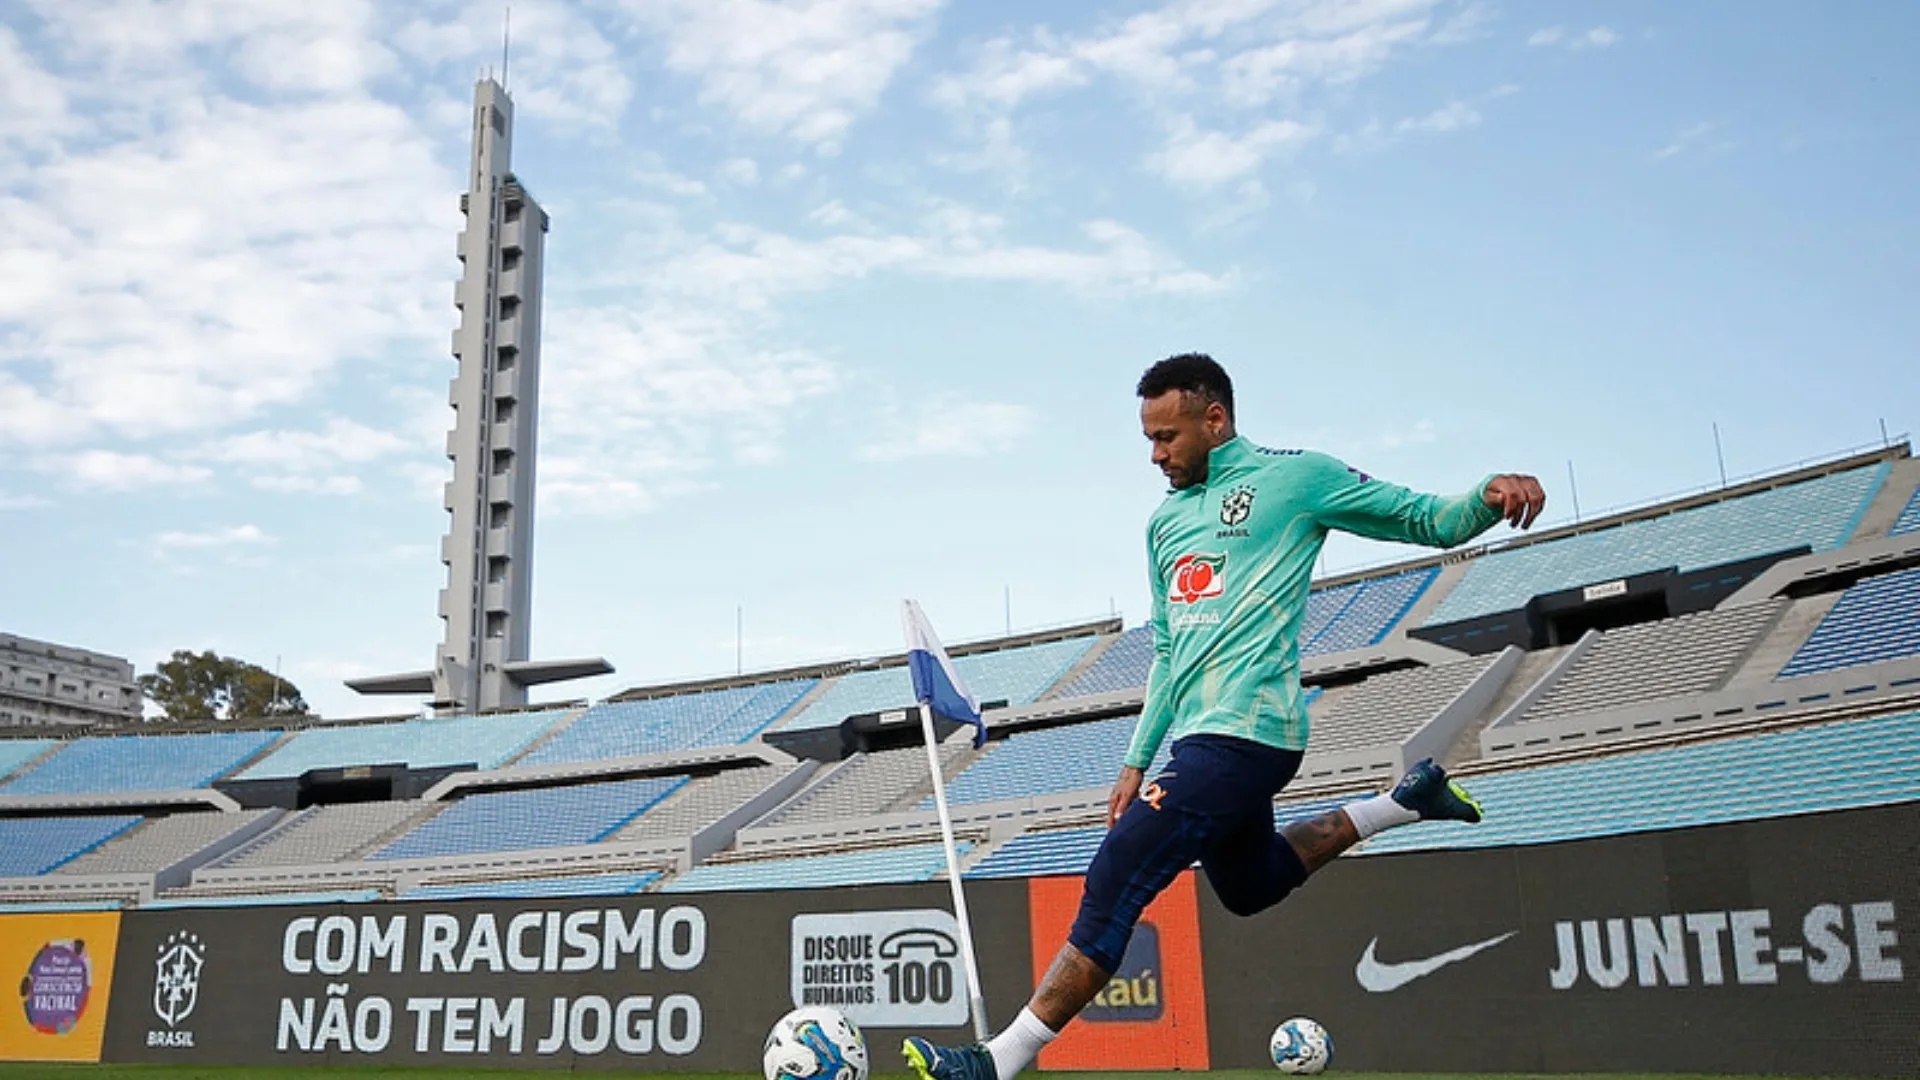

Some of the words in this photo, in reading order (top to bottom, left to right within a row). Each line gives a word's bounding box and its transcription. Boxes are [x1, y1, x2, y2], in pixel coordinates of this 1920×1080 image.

[282, 915, 407, 974] COM
[419, 905, 707, 973] RACISMO
[804, 935, 874, 961] DISQUE
[1550, 901, 1903, 989] JUNTE-SE
[803, 964, 875, 984] DIREITOS
[884, 960, 953, 1004] 100
[803, 985, 875, 1005] HUMANOS
[276, 983, 392, 1053] NÃO
[407, 997, 526, 1053] TEM
[537, 994, 702, 1055] JOGO
[146, 1031, 195, 1047] BRASIL
